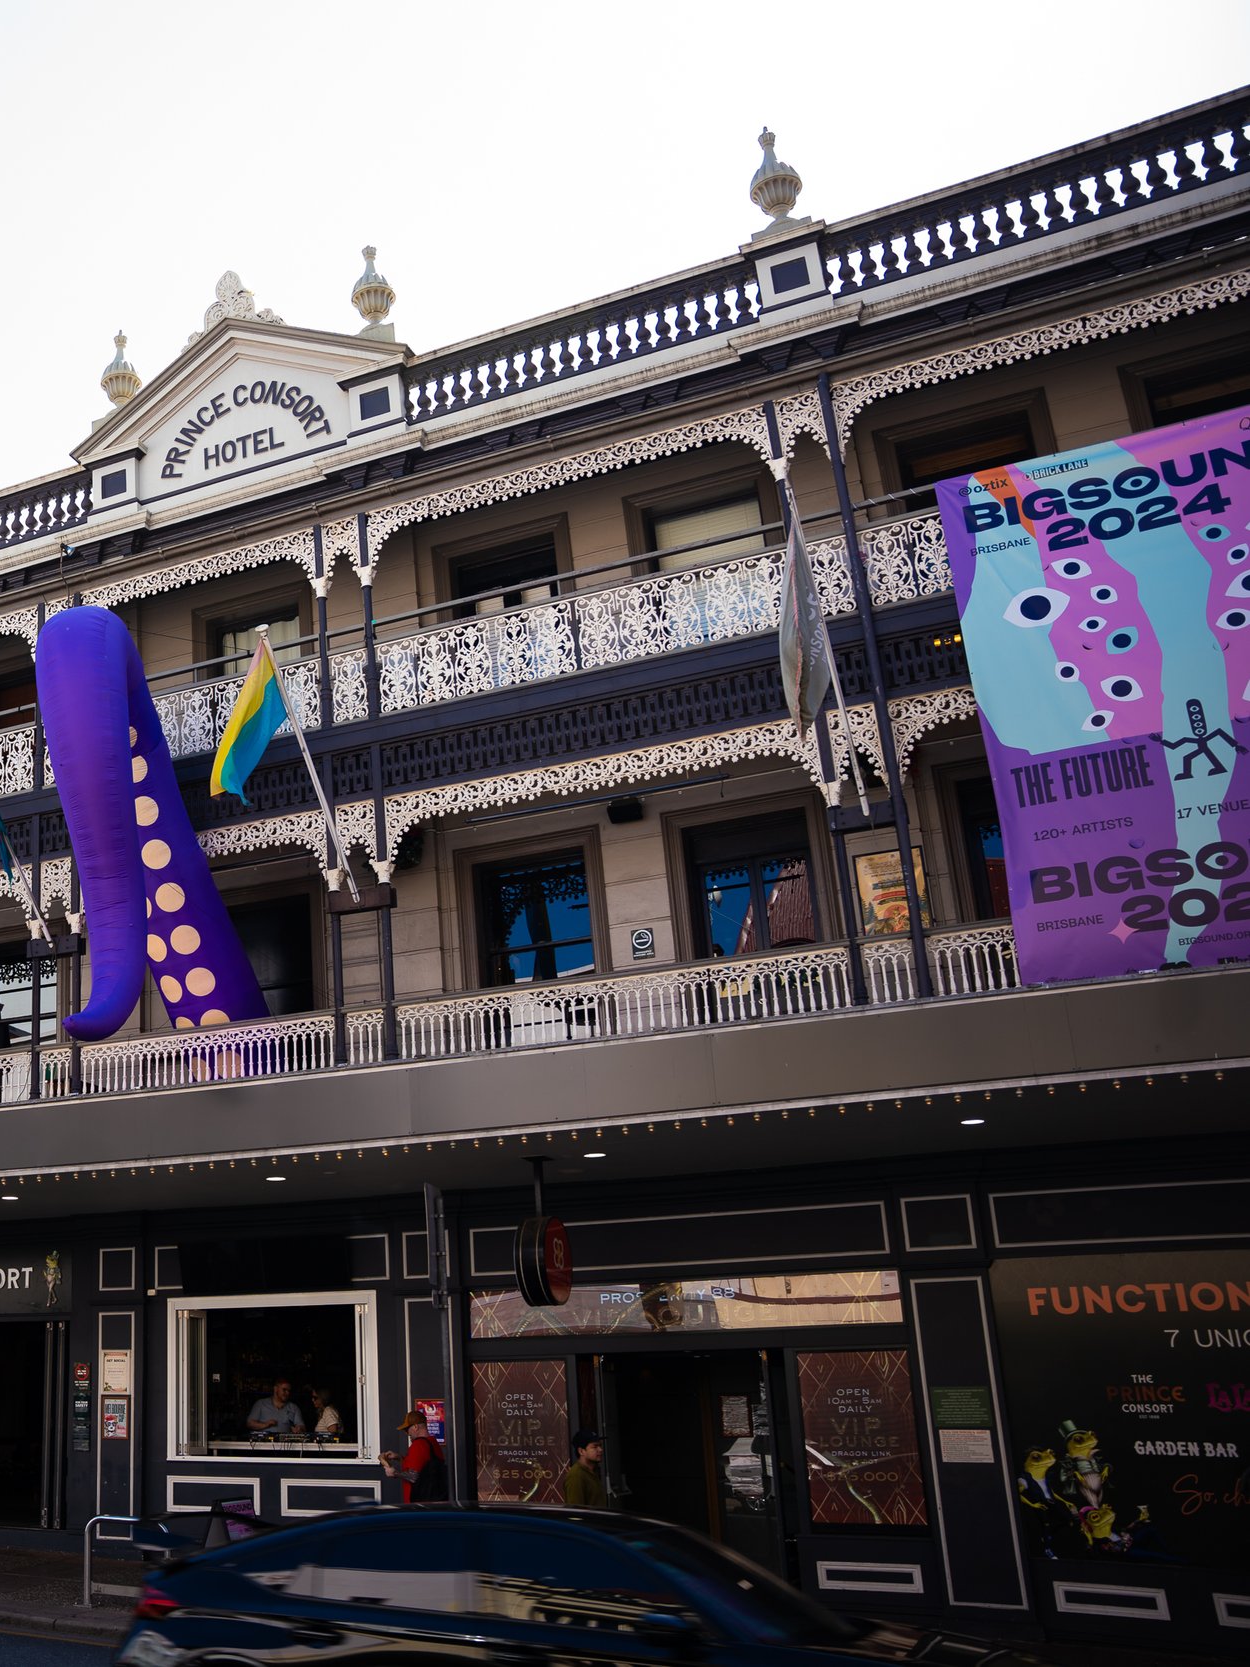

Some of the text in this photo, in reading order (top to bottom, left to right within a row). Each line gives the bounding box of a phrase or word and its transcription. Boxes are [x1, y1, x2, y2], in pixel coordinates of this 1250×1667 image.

[161, 380, 332, 479] PRINCE CONSORT
[203, 427, 285, 470] HOTEL
[973, 478, 1009, 495] oztix
[1046, 483, 1232, 552] 2024
[970, 537, 1032, 557] BRISBANE
[1010, 745, 1155, 809] THE FUTURE
[1177, 808, 1192, 819] 17
[1033, 816, 1134, 842] 120+ ARTISTS
[1029, 841, 1250, 905] BIGSO
[1036, 914, 1105, 933] BRISBANE
[712, 1287, 735, 1299] 88
[1163, 1329, 1180, 1348] 7
[1130, 1374, 1154, 1384] THE
[505, 1393, 534, 1401] OPEN
[827, 1397, 852, 1405] 10AM
[862, 1396, 882, 1405] 5AM
[836, 1388, 870, 1397] OPEN
[1105, 1384, 1186, 1403] PRINCE
[497, 1401, 518, 1409] 10AM
[526, 1401, 543, 1409] 5AM
[506, 1408, 535, 1416] DAILY
[838, 1405, 872, 1413] DAILY
[1121, 1403, 1175, 1414] CONSORT
[499, 1419, 542, 1436] VIP
[830, 1417, 882, 1435] VIP
[488, 1435, 556, 1447] LOUNGE
[819, 1435, 900, 1448] LOUNGE
[1134, 1440, 1239, 1458] GARDEN BAR
